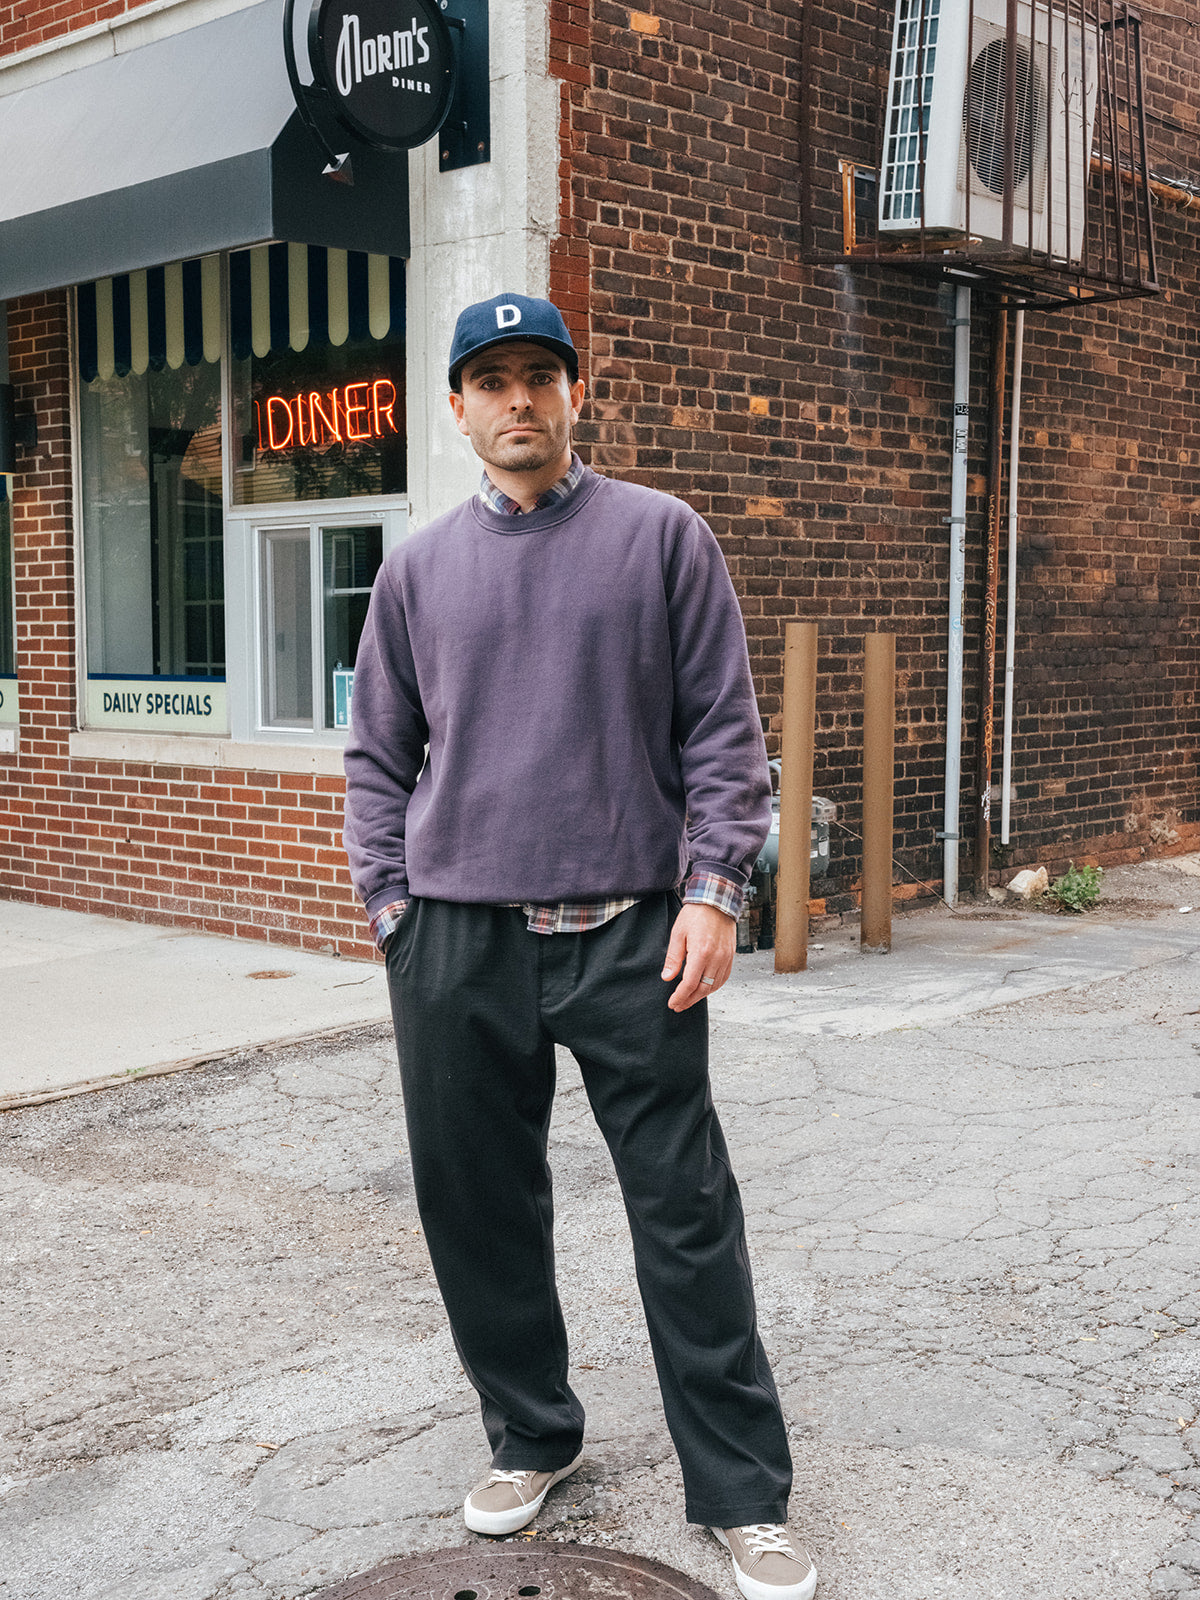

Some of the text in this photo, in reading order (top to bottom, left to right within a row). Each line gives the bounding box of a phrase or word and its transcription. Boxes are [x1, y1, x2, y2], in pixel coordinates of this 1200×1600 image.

[392, 76, 431, 94] DINER
[495, 304, 522, 329] D
[266, 379, 398, 449] DINER
[103, 692, 212, 716] DAILY SPECIALS
